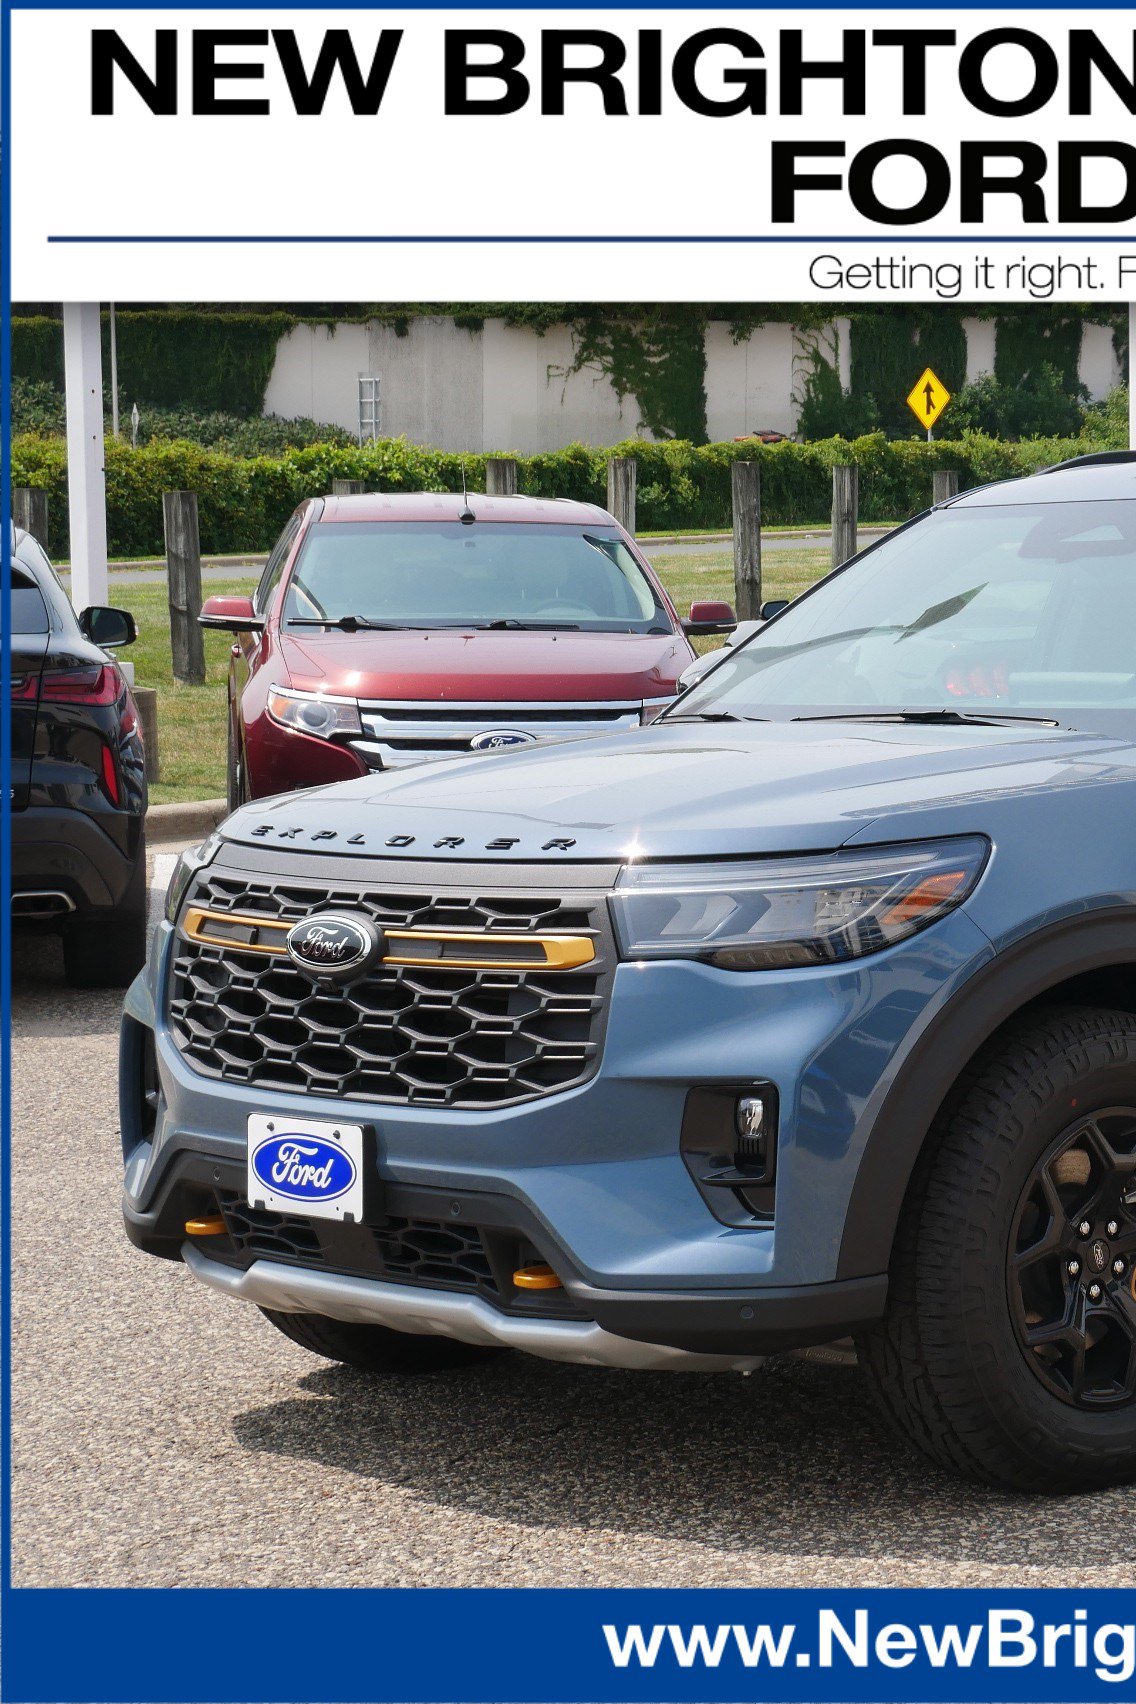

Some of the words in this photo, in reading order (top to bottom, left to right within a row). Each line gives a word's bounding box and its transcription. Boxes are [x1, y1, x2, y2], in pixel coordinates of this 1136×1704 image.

[250, 824, 578, 852] EXPLORER
[301, 926, 350, 959] Ford
[271, 1142, 335, 1189] Ford
